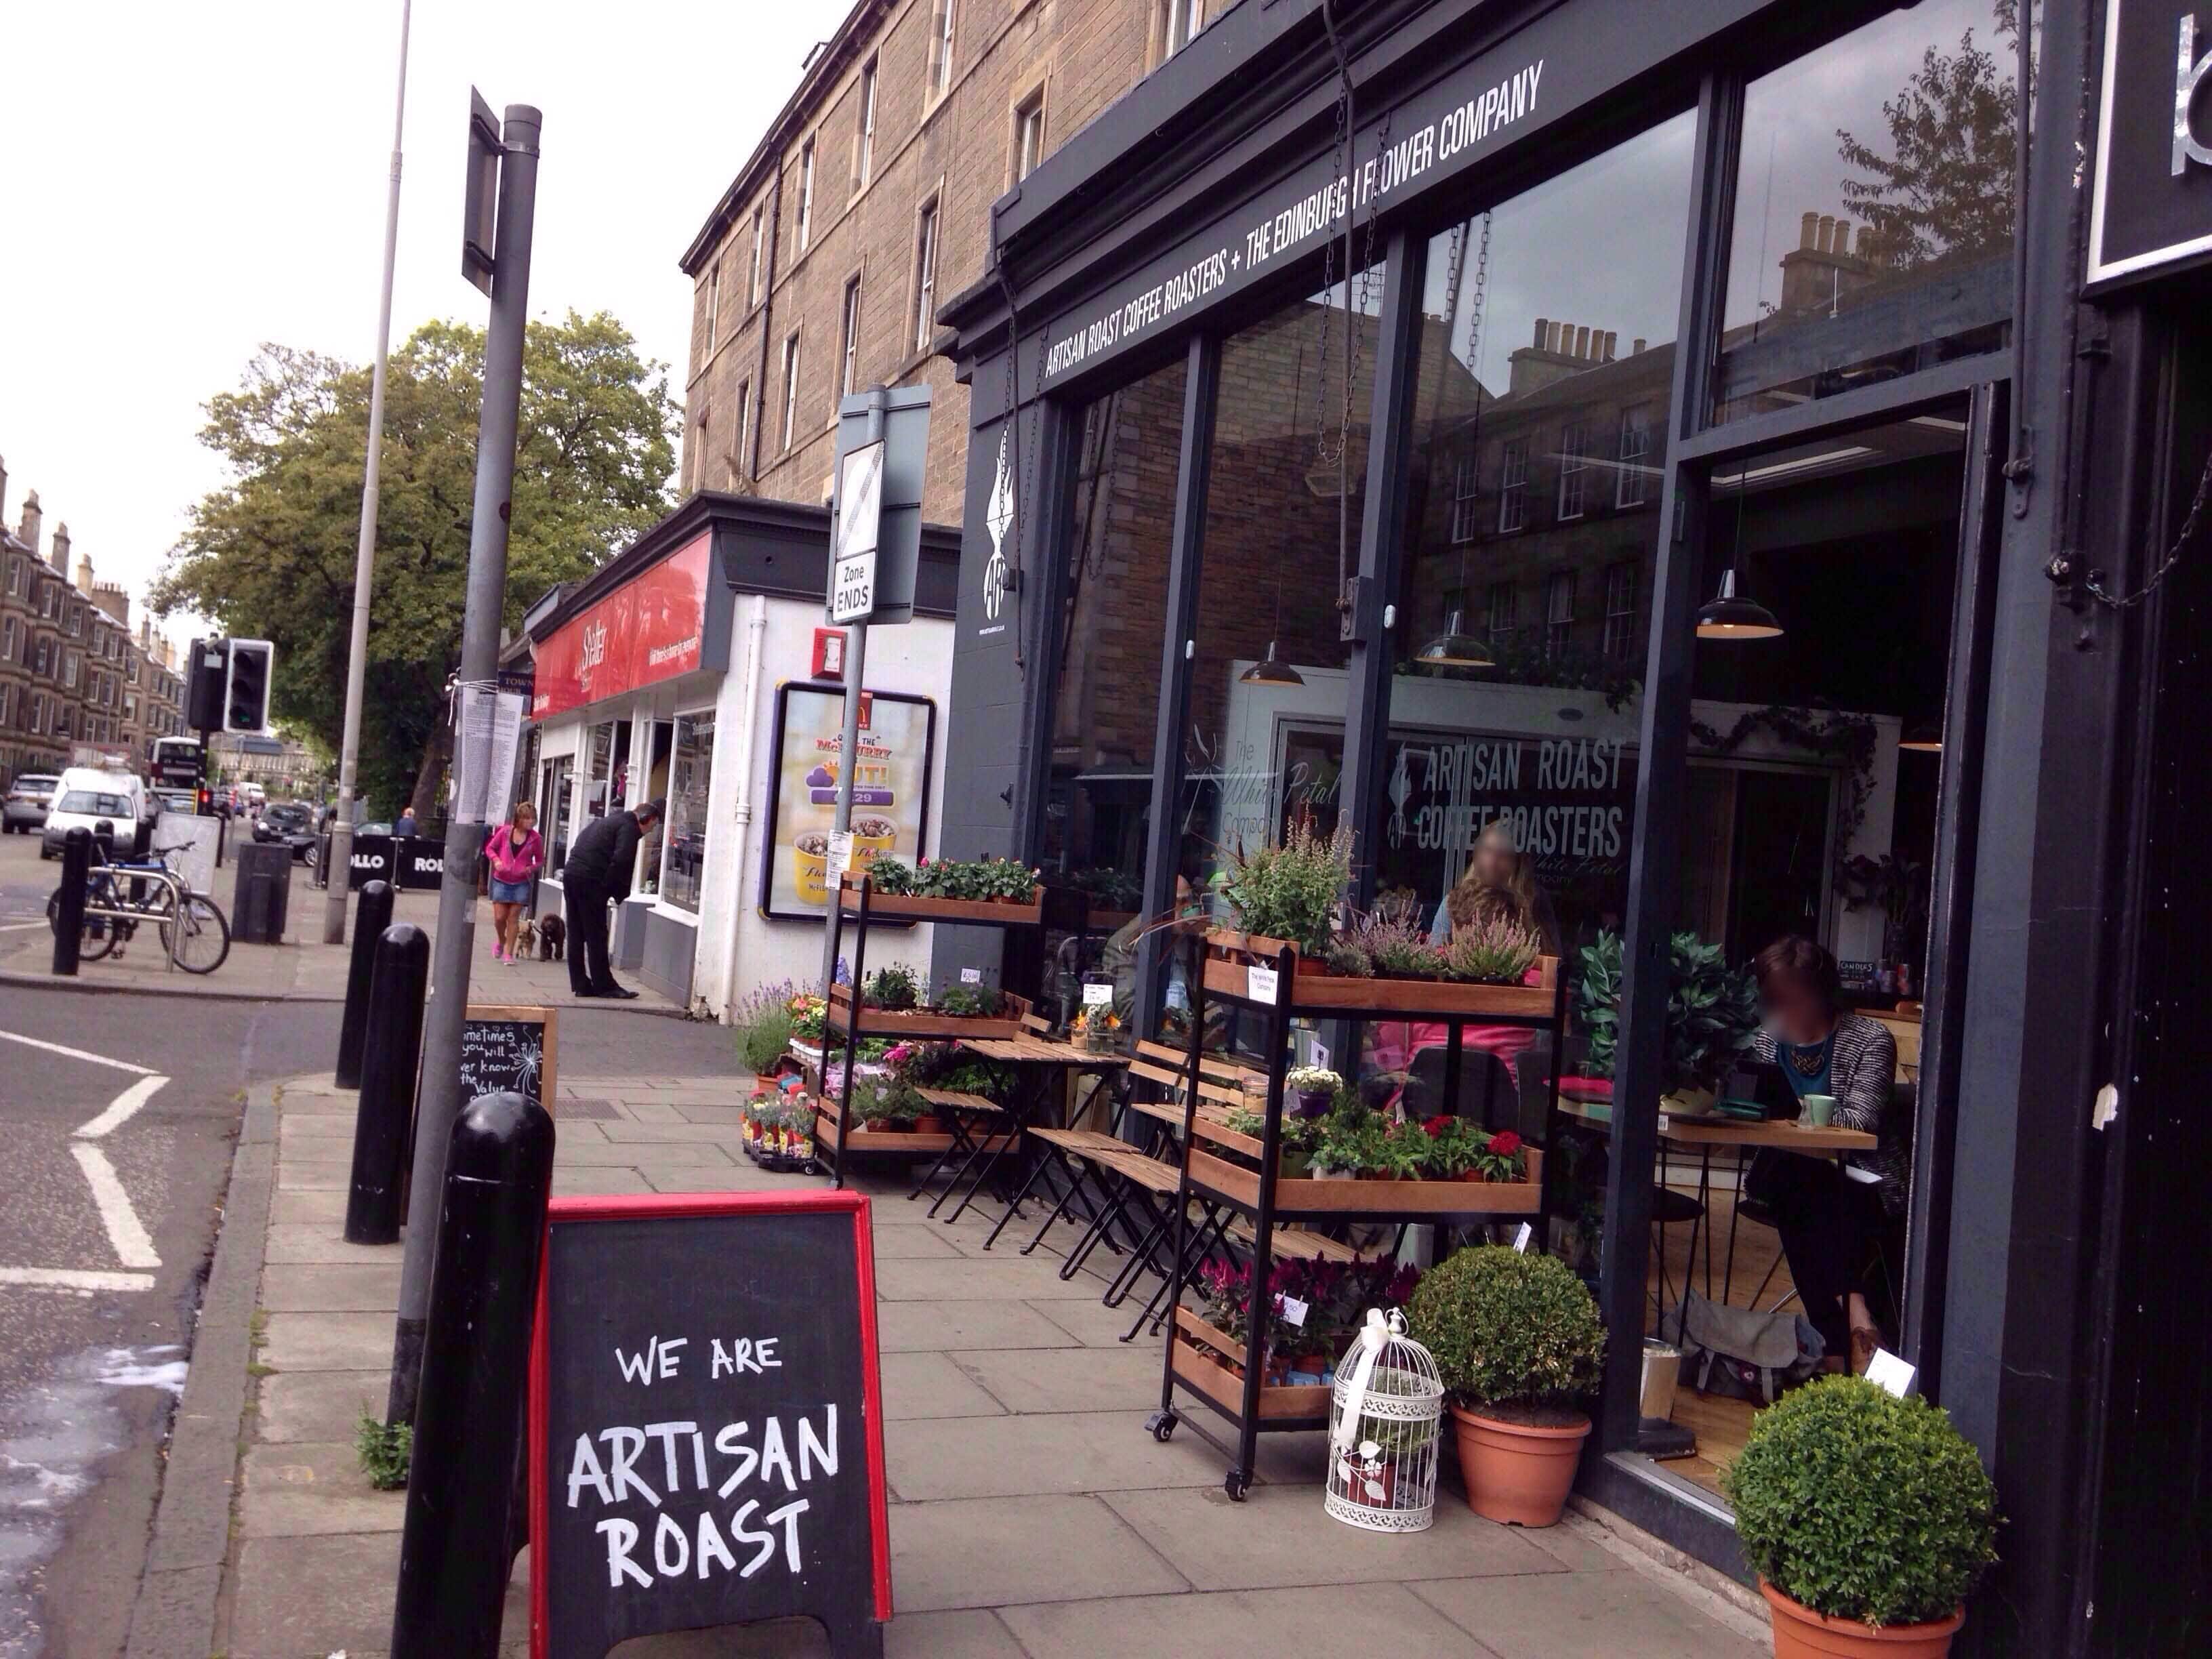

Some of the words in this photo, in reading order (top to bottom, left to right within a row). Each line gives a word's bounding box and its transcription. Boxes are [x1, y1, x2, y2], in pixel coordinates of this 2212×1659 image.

[1046, 329, 1086, 378] ARTISAN
[1087, 308, 1122, 356] ROAST
[1122, 285, 1162, 337] COFFEE
[1164, 248, 1227, 314] ROASTERS
[1247, 221, 1271, 270] THE
[1362, 125, 1434, 205] FLOWER
[1439, 59, 1544, 161] COMPANY
[844, 566, 864, 583] Zone
[838, 586, 869, 612] ENDS
[862, 737, 876, 745] THE
[1236, 741, 1254, 760] The
[1423, 742, 1521, 792] ARTISAN
[1538, 737, 1626, 790] ROAST
[1284, 762, 1342, 804] Petal
[350, 854, 384, 869] LLO
[415, 857, 444, 872] ROL
[463, 1025, 515, 1042] metimes
[462, 1044, 484, 1057] you
[485, 1046, 505, 1057] will
[480, 1059, 510, 1073] know
[460, 1073, 476, 1084] the
[615, 1336, 687, 1385] WE
[711, 1338, 782, 1378] ARE
[567, 1404, 838, 1507] ARTISAN
[596, 1499, 809, 1588] ROAST
